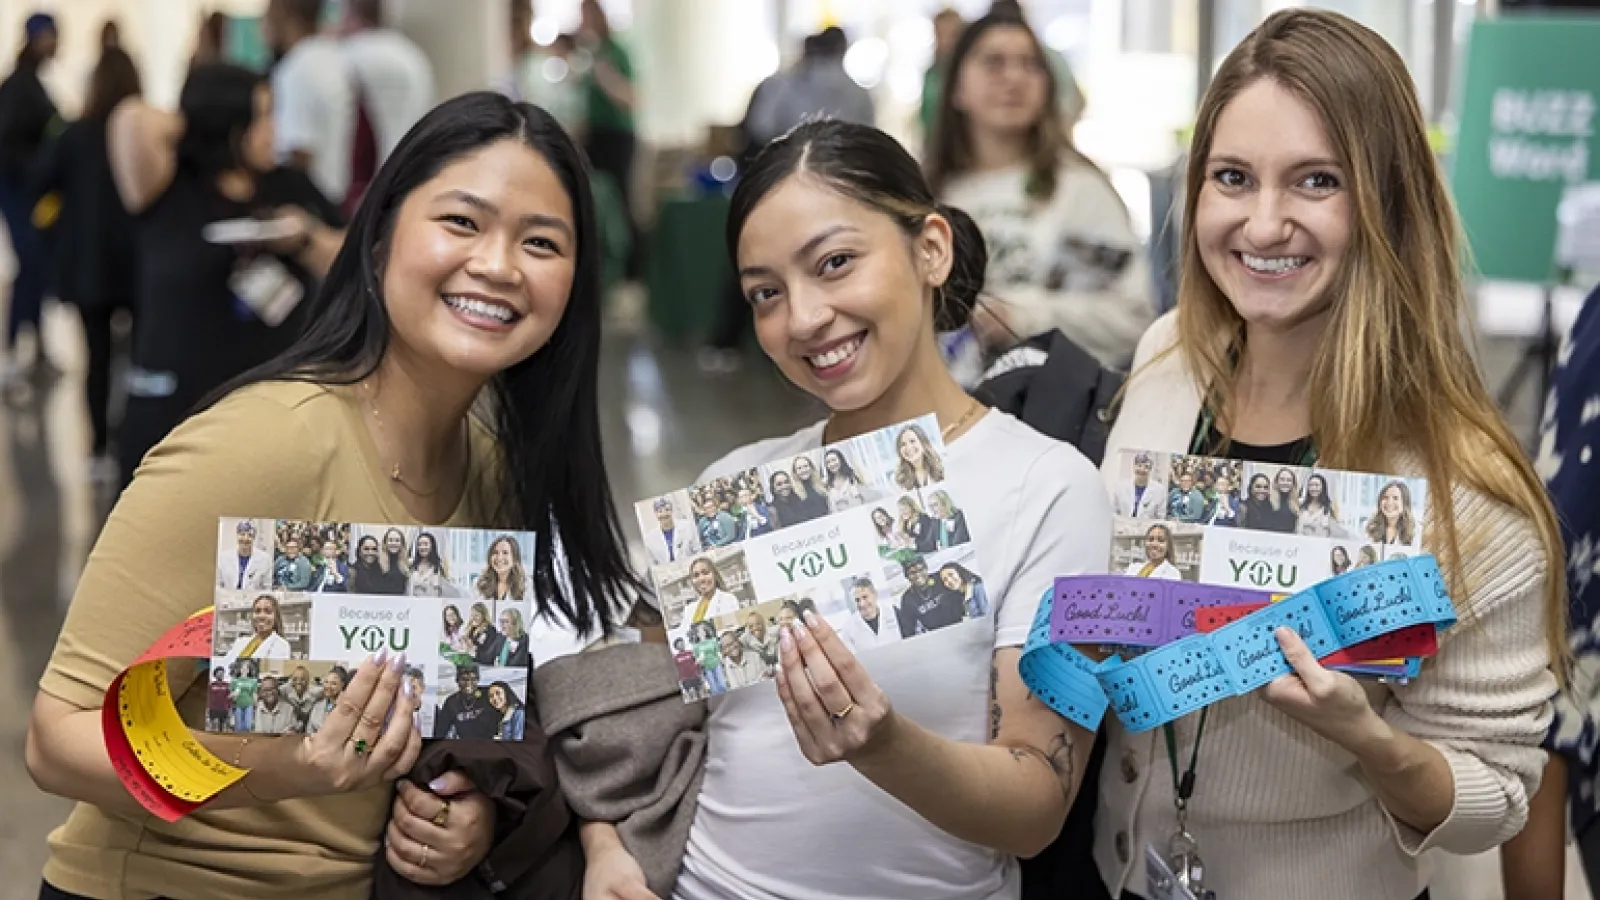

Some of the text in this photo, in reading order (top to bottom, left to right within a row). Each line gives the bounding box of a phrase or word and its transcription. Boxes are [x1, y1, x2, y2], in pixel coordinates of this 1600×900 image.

[1490, 137, 1587, 182] Word
[772, 525, 840, 556] Because of
[1229, 540, 1297, 558] Because of
[777, 543, 848, 582] YOU
[1229, 557, 1297, 588] YOU
[339, 606, 411, 621] Because of
[1064, 602, 1151, 623] Good Luck!
[1335, 597, 1371, 625] Good
[1373, 585, 1412, 612] Luck!
[339, 625, 410, 651] YOU
[1237, 639, 1275, 669] Good
[1169, 664, 1204, 694] Good
